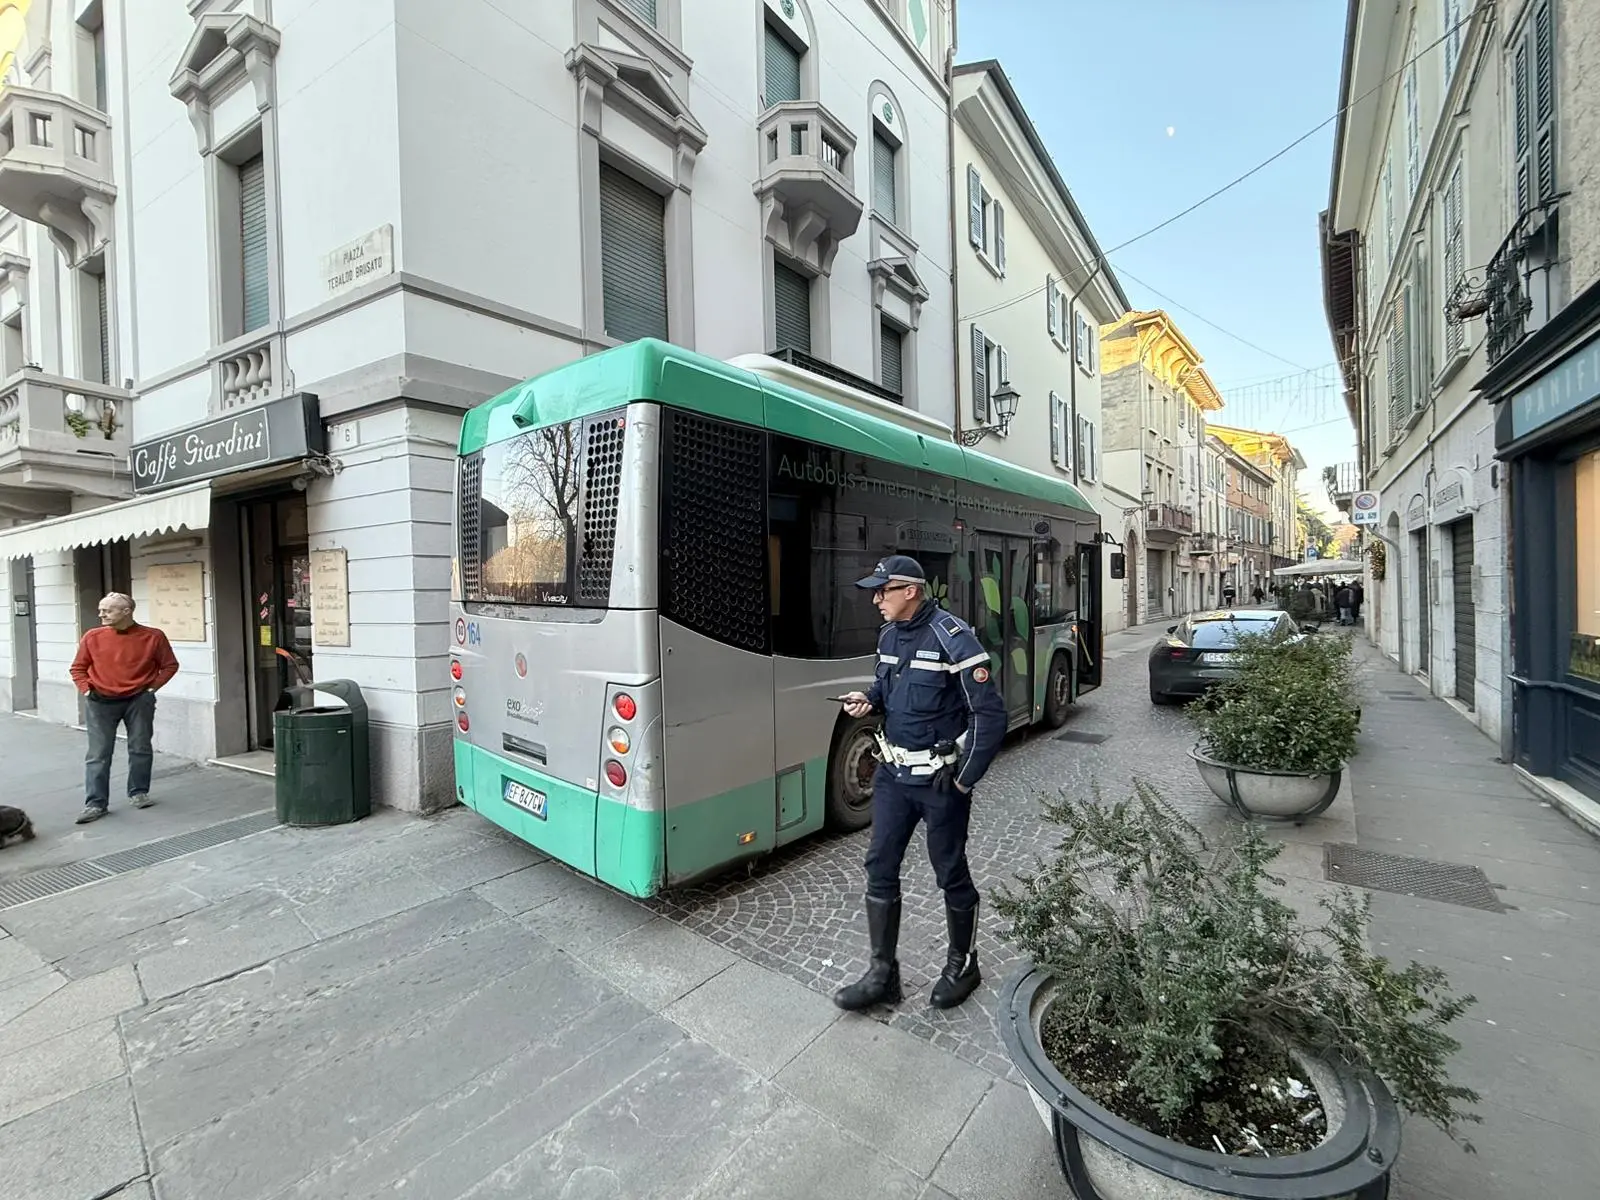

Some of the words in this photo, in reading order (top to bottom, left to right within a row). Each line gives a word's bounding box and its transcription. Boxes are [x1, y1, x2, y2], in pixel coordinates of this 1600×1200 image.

[343, 245, 364, 264] PIAZZA
[355, 256, 383, 278] BRUSATO
[183, 421, 264, 466] Giardini
[344, 428, 351, 442] 6
[777, 454, 856, 488] Autobus
[860, 476, 868, 491] a
[873, 477, 925, 500] metano
[947, 488, 981, 511] Green
[467, 622, 481, 645] 164
